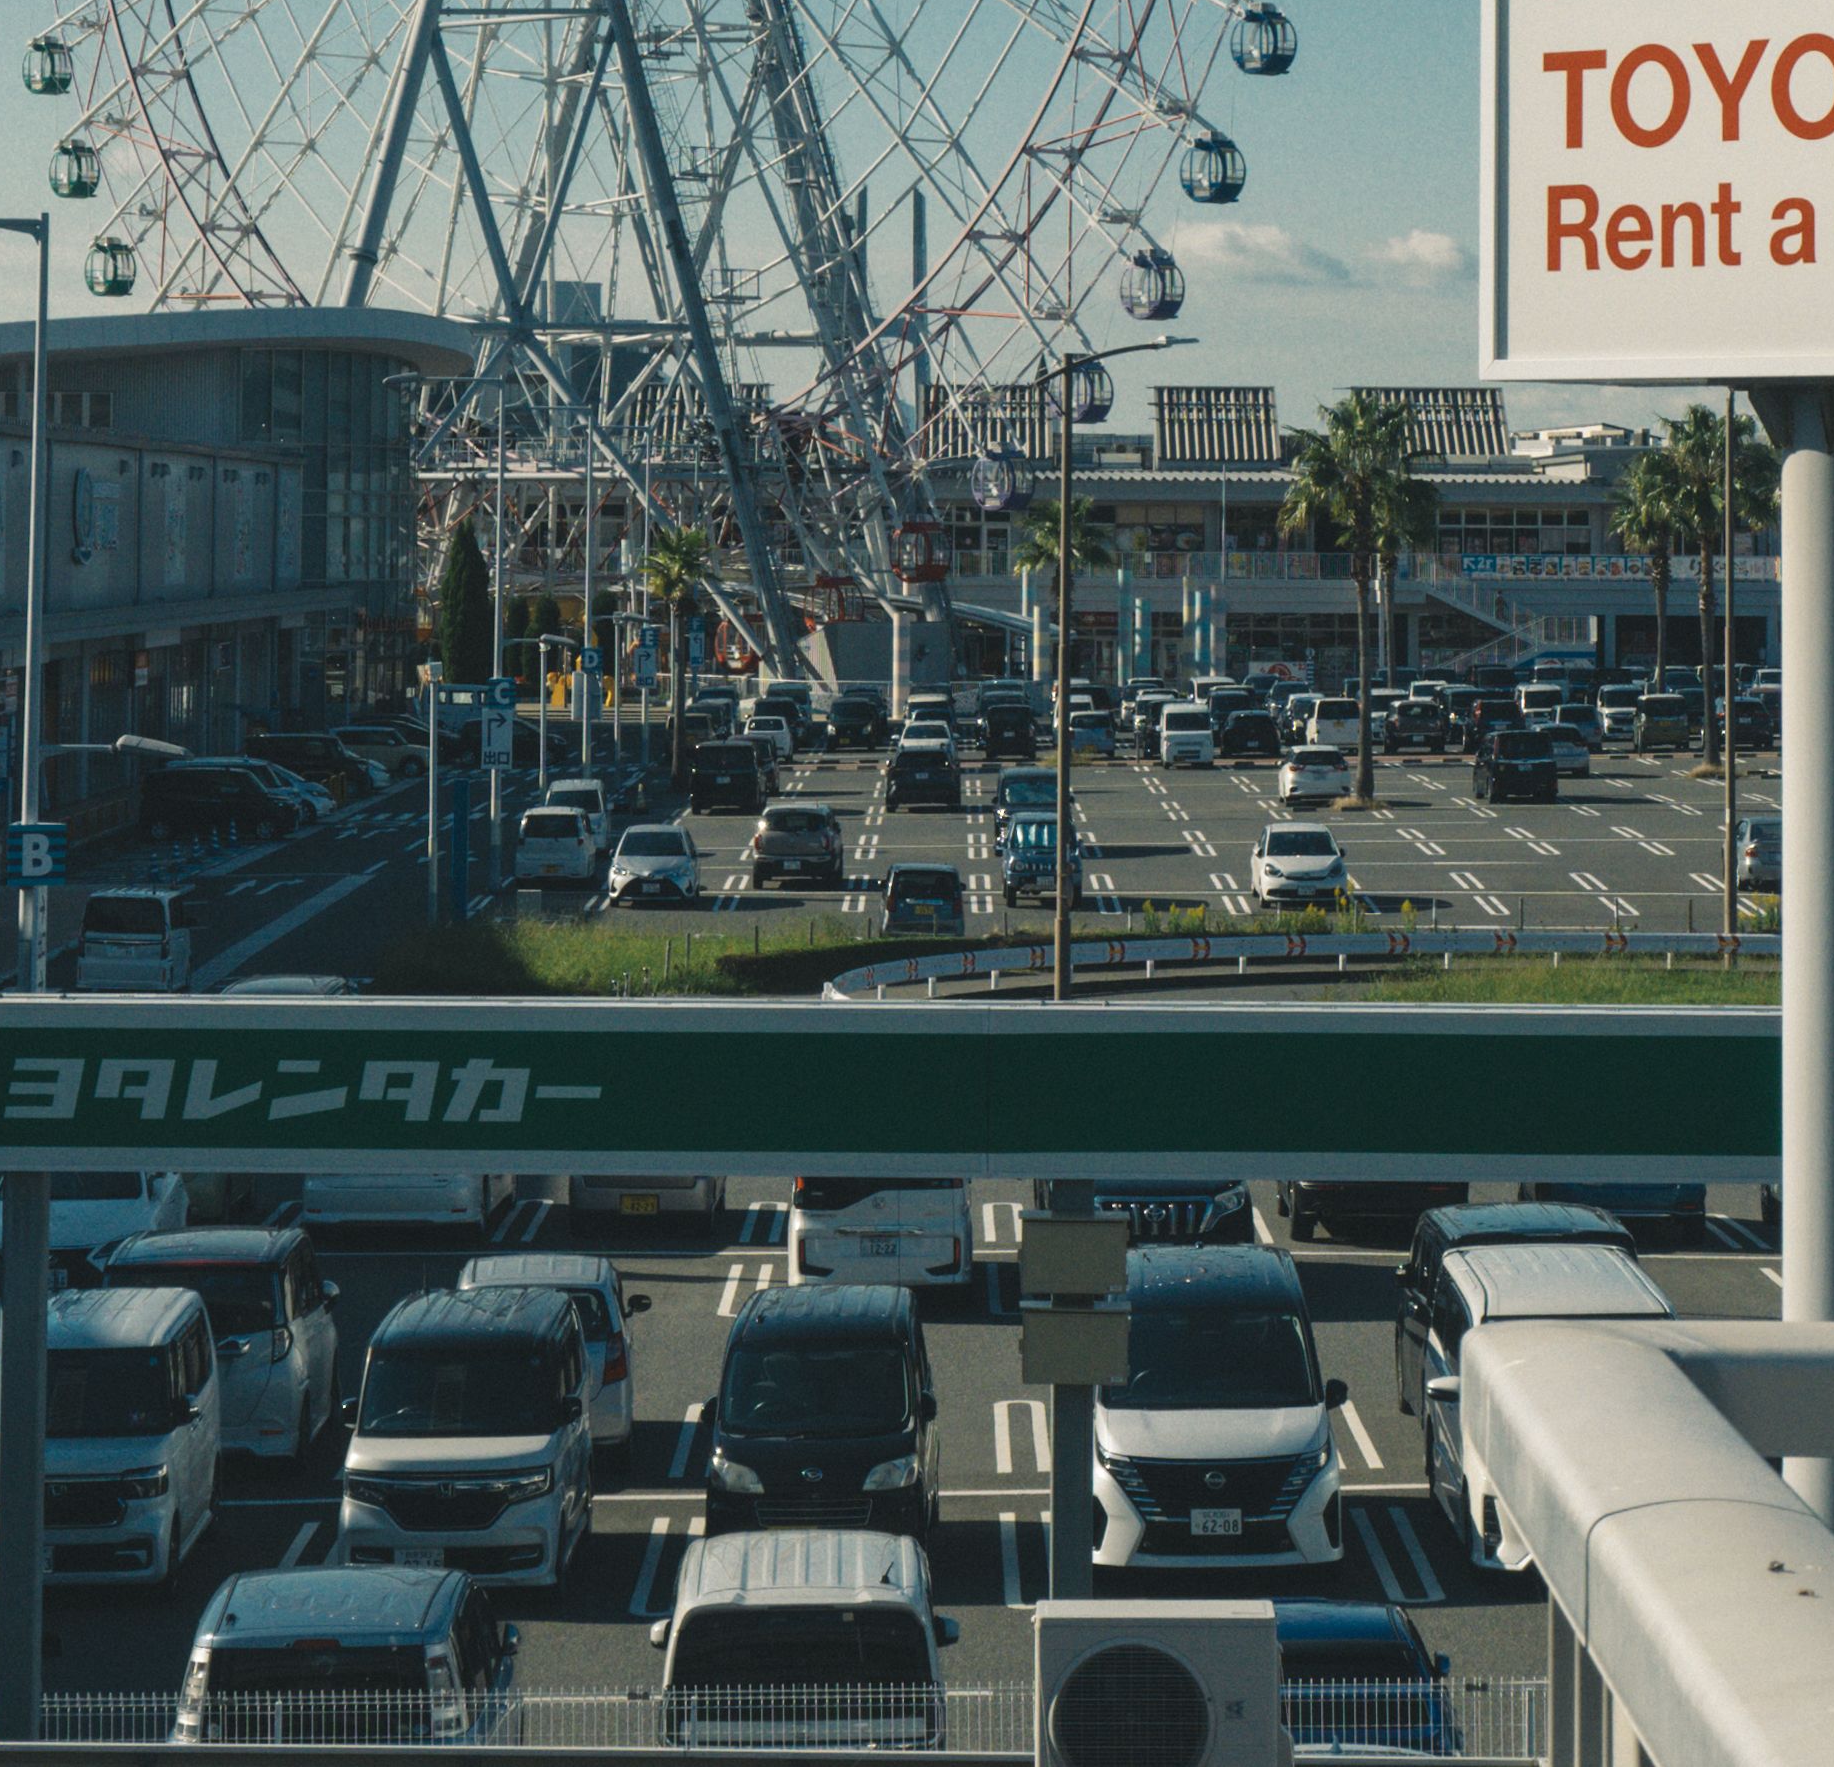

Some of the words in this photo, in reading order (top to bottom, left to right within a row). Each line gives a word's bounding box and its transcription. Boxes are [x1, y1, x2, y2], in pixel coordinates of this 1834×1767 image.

[1545, 182, 1741, 272] Rent
[1768, 197, 1815, 266] a
[647, 630, 655, 645] E
[587, 651, 599, 668] D
[494, 682, 510, 704] C
[483, 750, 510, 765] 出口
[22, 833, 53, 877] B
[1202, 1519, 1239, 1533] 62-08
